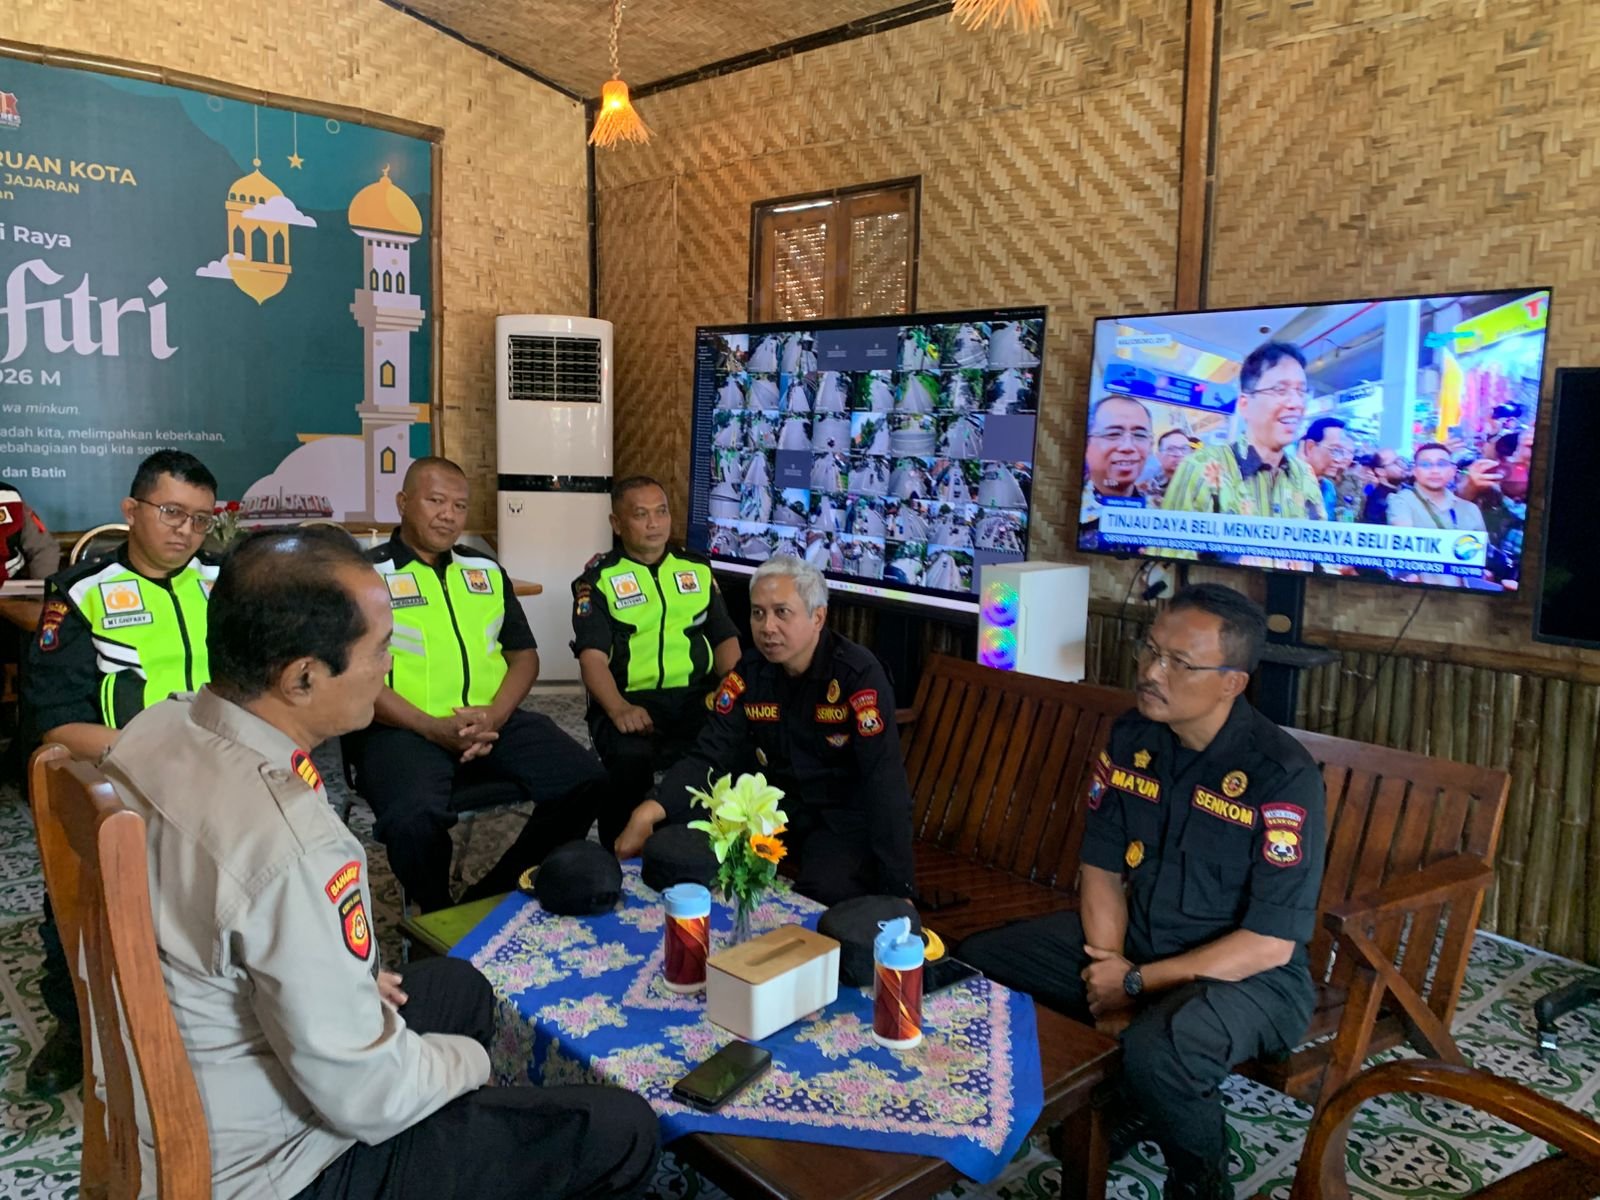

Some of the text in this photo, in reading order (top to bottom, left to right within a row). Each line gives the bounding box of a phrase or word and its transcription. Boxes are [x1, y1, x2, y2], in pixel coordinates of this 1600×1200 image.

[70, 160, 137, 186] KOTA
[4, 173, 79, 194] JAJARAN
[14, 225, 71, 249] Raya
[41, 371, 61, 386] M
[3, 405, 22, 414] wa
[37, 427, 64, 440] kita,
[68, 429, 153, 443] melimpahkan
[155, 430, 226, 442] keberkahan,
[80, 443, 108, 456] bagi
[111, 444, 134, 454] kita
[2, 467, 67, 478] dan Batin
[1108, 513, 1442, 554] TINJAU DAYA BELI, MENKEU PURBAYA BELI BATIK
[1195, 789, 1254, 826] SENKOM
